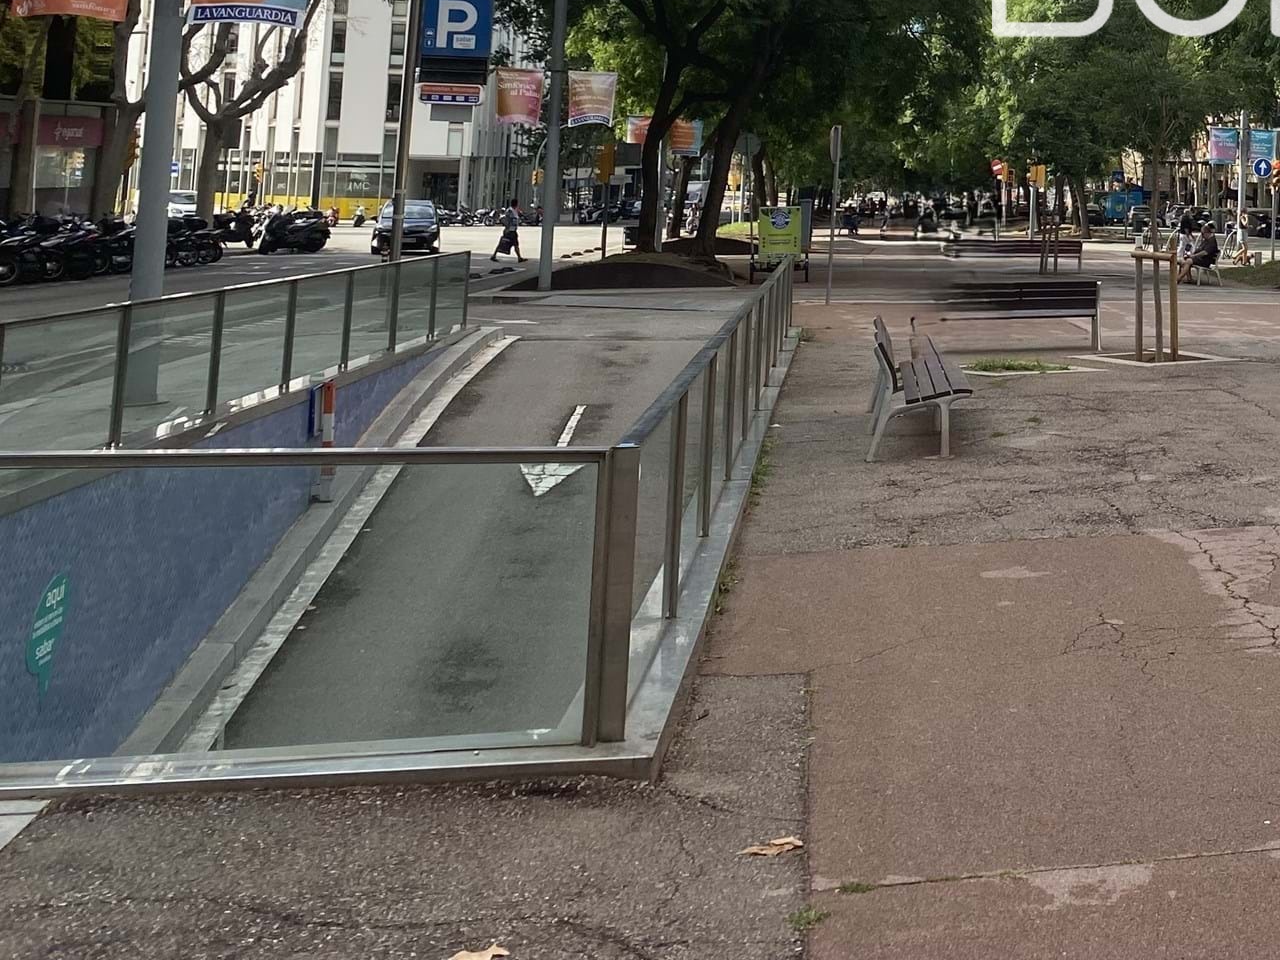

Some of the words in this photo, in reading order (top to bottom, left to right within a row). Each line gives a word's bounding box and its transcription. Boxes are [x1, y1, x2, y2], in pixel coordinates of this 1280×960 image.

[197, 8, 211, 19] LA
[211, 7, 293, 24] VANGUARDIA
[436, 0, 478, 48] P
